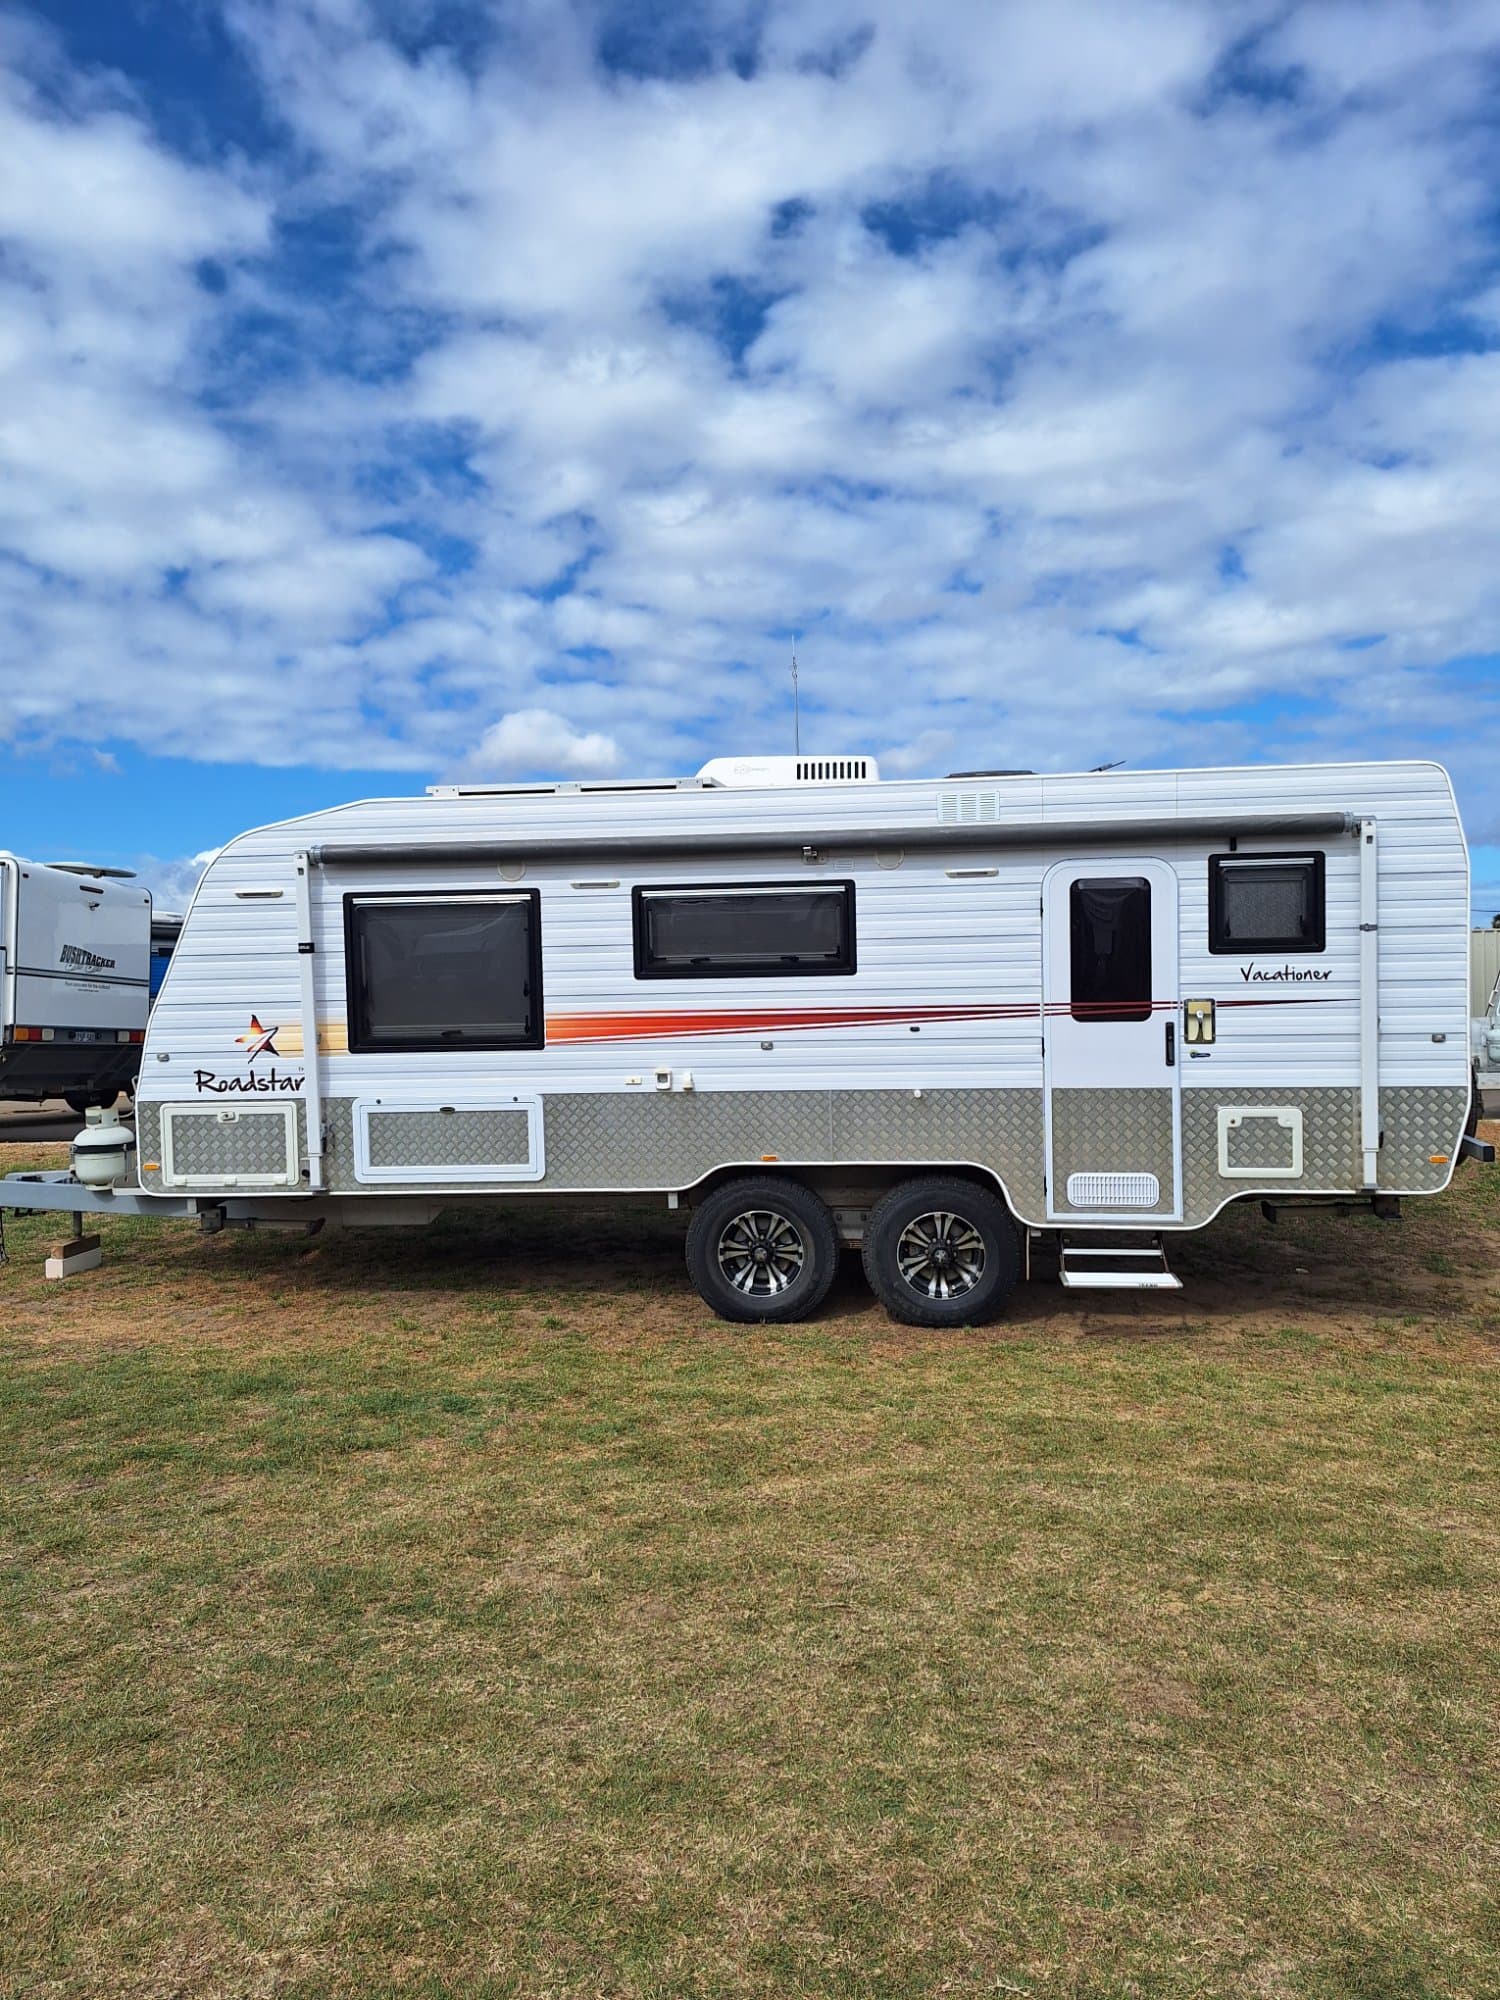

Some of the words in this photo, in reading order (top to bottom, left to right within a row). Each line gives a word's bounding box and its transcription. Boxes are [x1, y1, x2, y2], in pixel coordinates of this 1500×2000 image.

[59, 944, 116, 968] BUSHTRACKER
[1240, 961, 1333, 982] Vacationer
[193, 1067, 306, 1093] Roadstar
